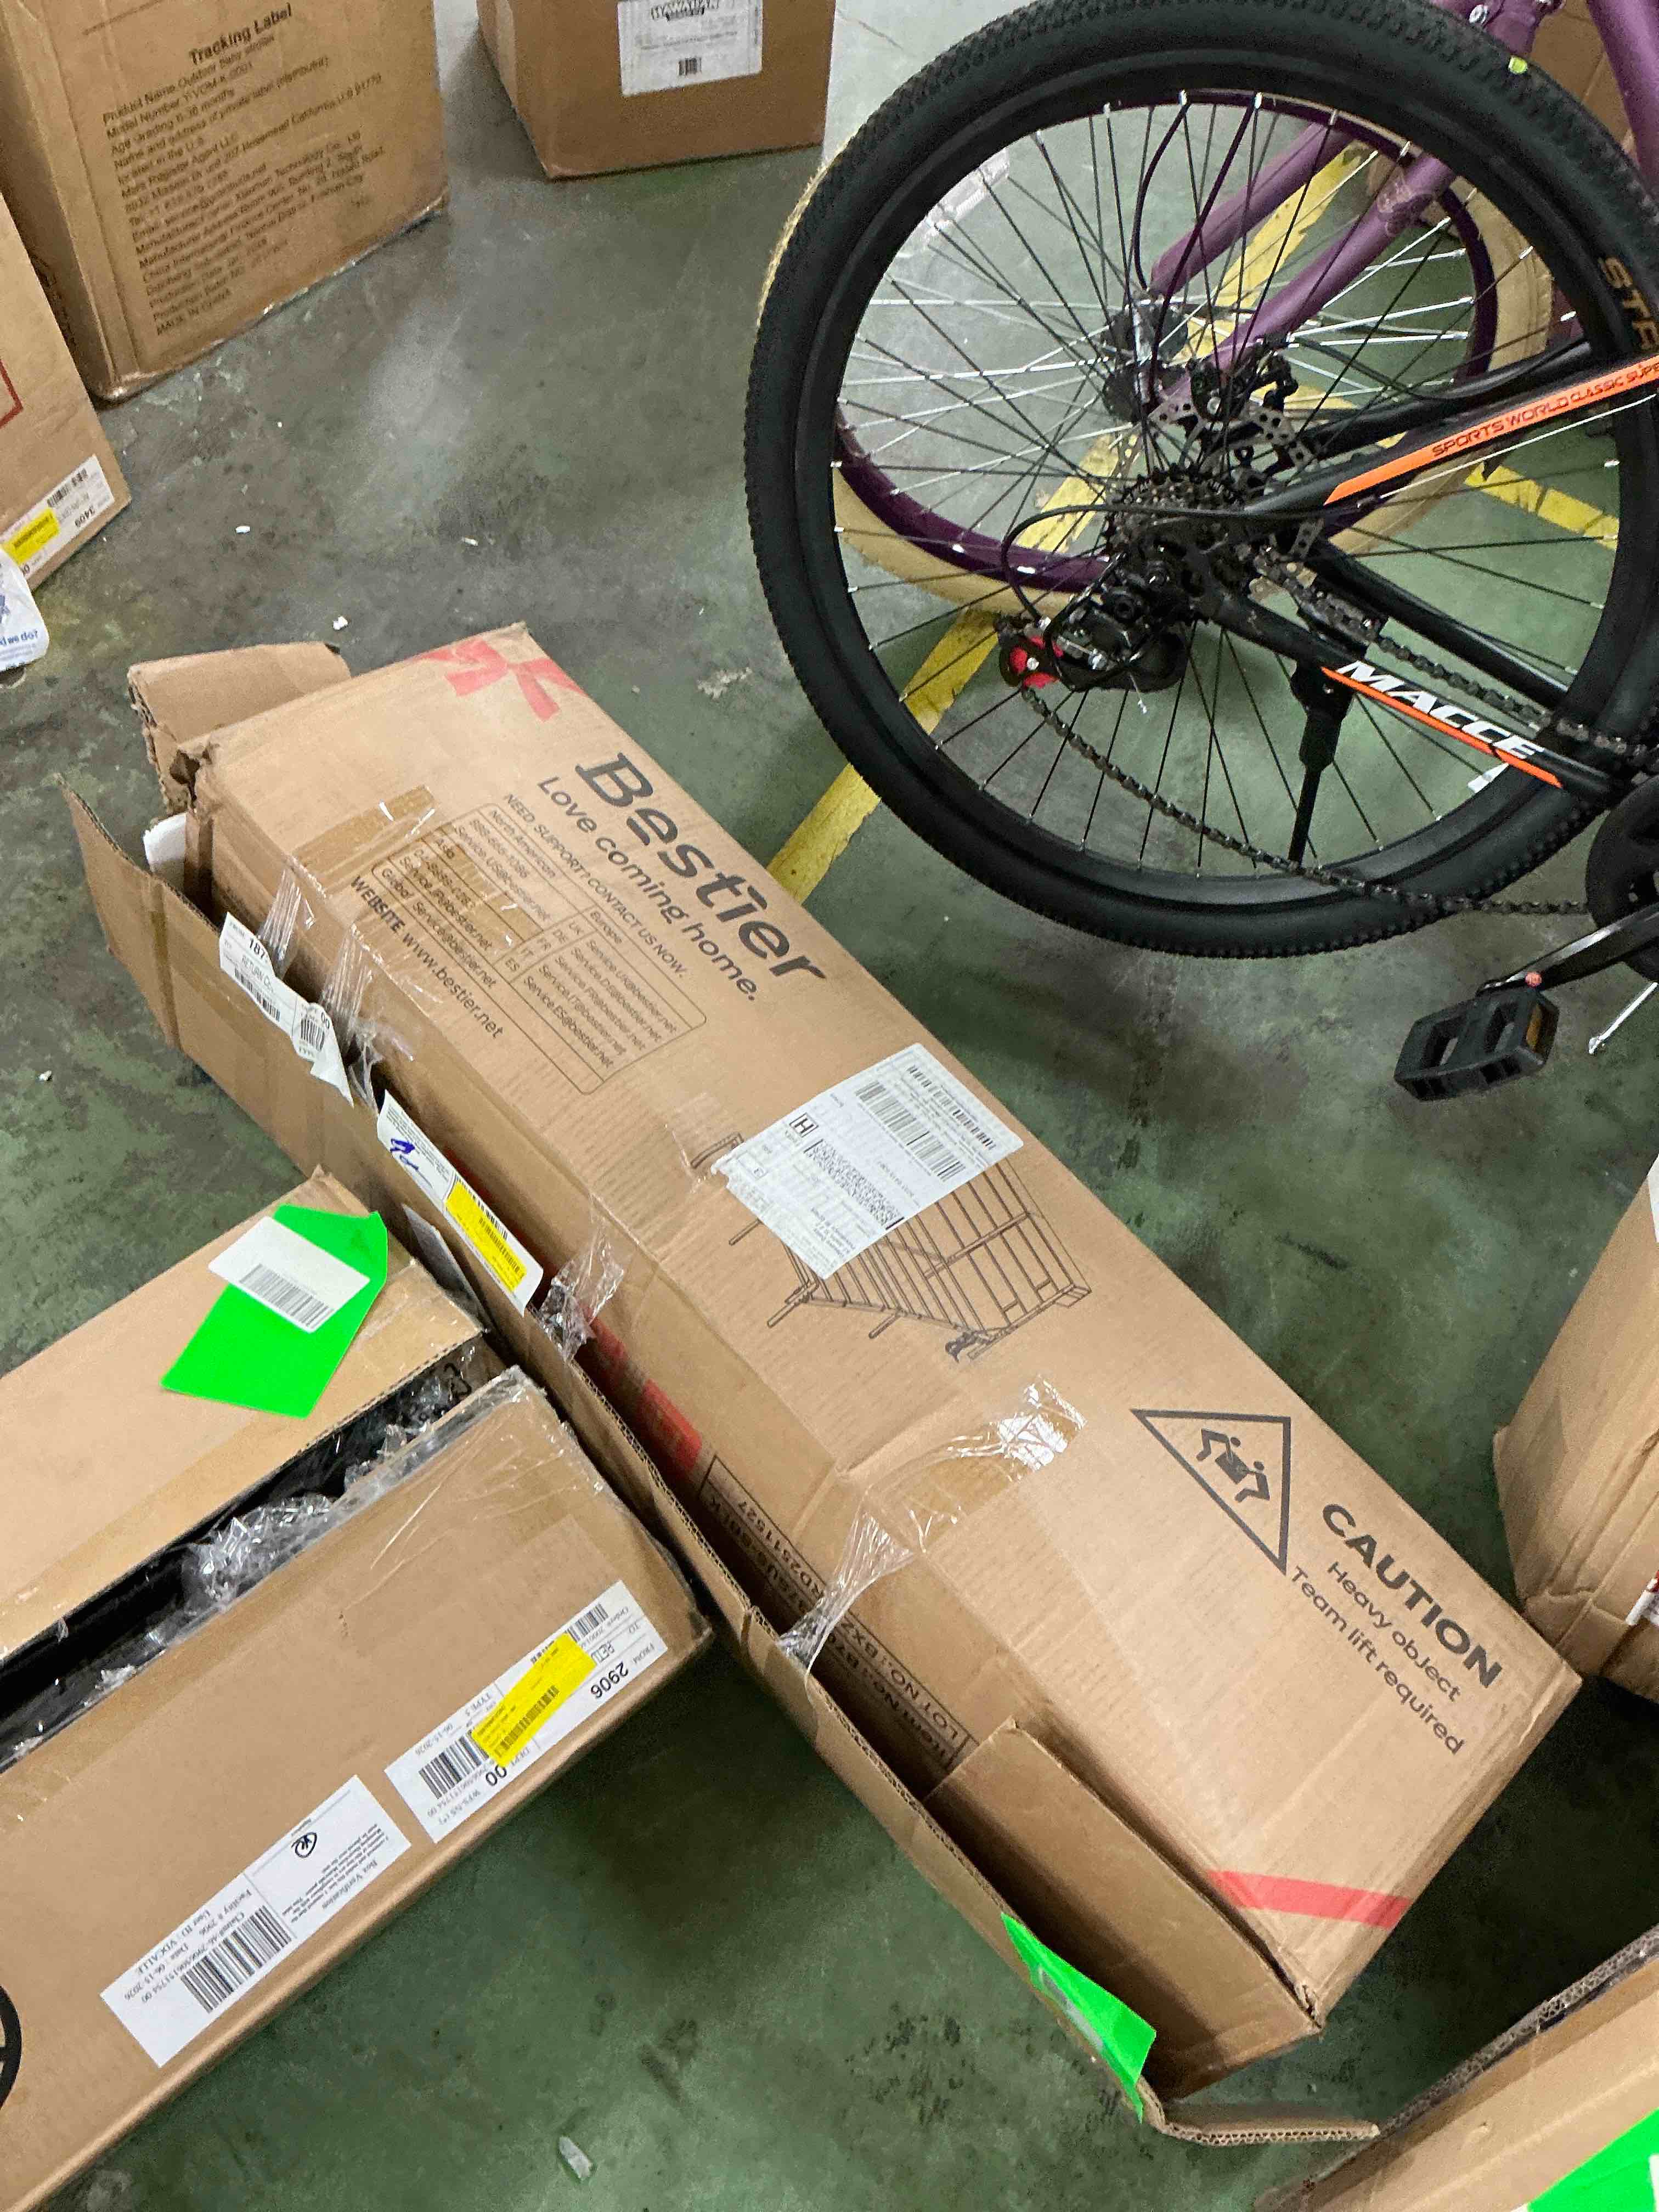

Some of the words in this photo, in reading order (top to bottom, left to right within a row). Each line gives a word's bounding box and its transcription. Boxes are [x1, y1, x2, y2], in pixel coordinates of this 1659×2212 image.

[188, 27, 252, 65] Tracking
[253, 2, 291, 35] Label
[1430, 419, 1506, 457] SPORTS
[1506, 396, 1570, 427] WORLD
[503, 793, 538, 823] NEED
[586, 877, 642, 929] CONTACT
[636, 928, 658, 946] US
[538, 775, 598, 833] Love
[596, 837, 690, 925] coming
[681, 919, 756, 1002] home.
[575, 752, 827, 980] Bestier
[347, 875, 407, 932] WEBSITE
[397, 930, 507, 1040] www.bestier.net
[587, 910, 626, 945] Europe
[504, 957, 522, 972] ES
[1322, 1503, 1502, 1688] CAUTION
[1292, 1566, 1347, 1633] Team
[1347, 1628, 1377, 1663] lift
[1375, 1657, 1464, 1757] required
[1328, 1561, 1392, 1629] Heavy
[1391, 1629, 1461, 1703] object
[585, 1661, 633, 1700] 2906
[919, 1699, 961, 1742] LOT
[482, 1762, 510, 1787] 00
[220, 1888, 253, 1915] Facility
[316, 1872, 365, 1909] Verification
